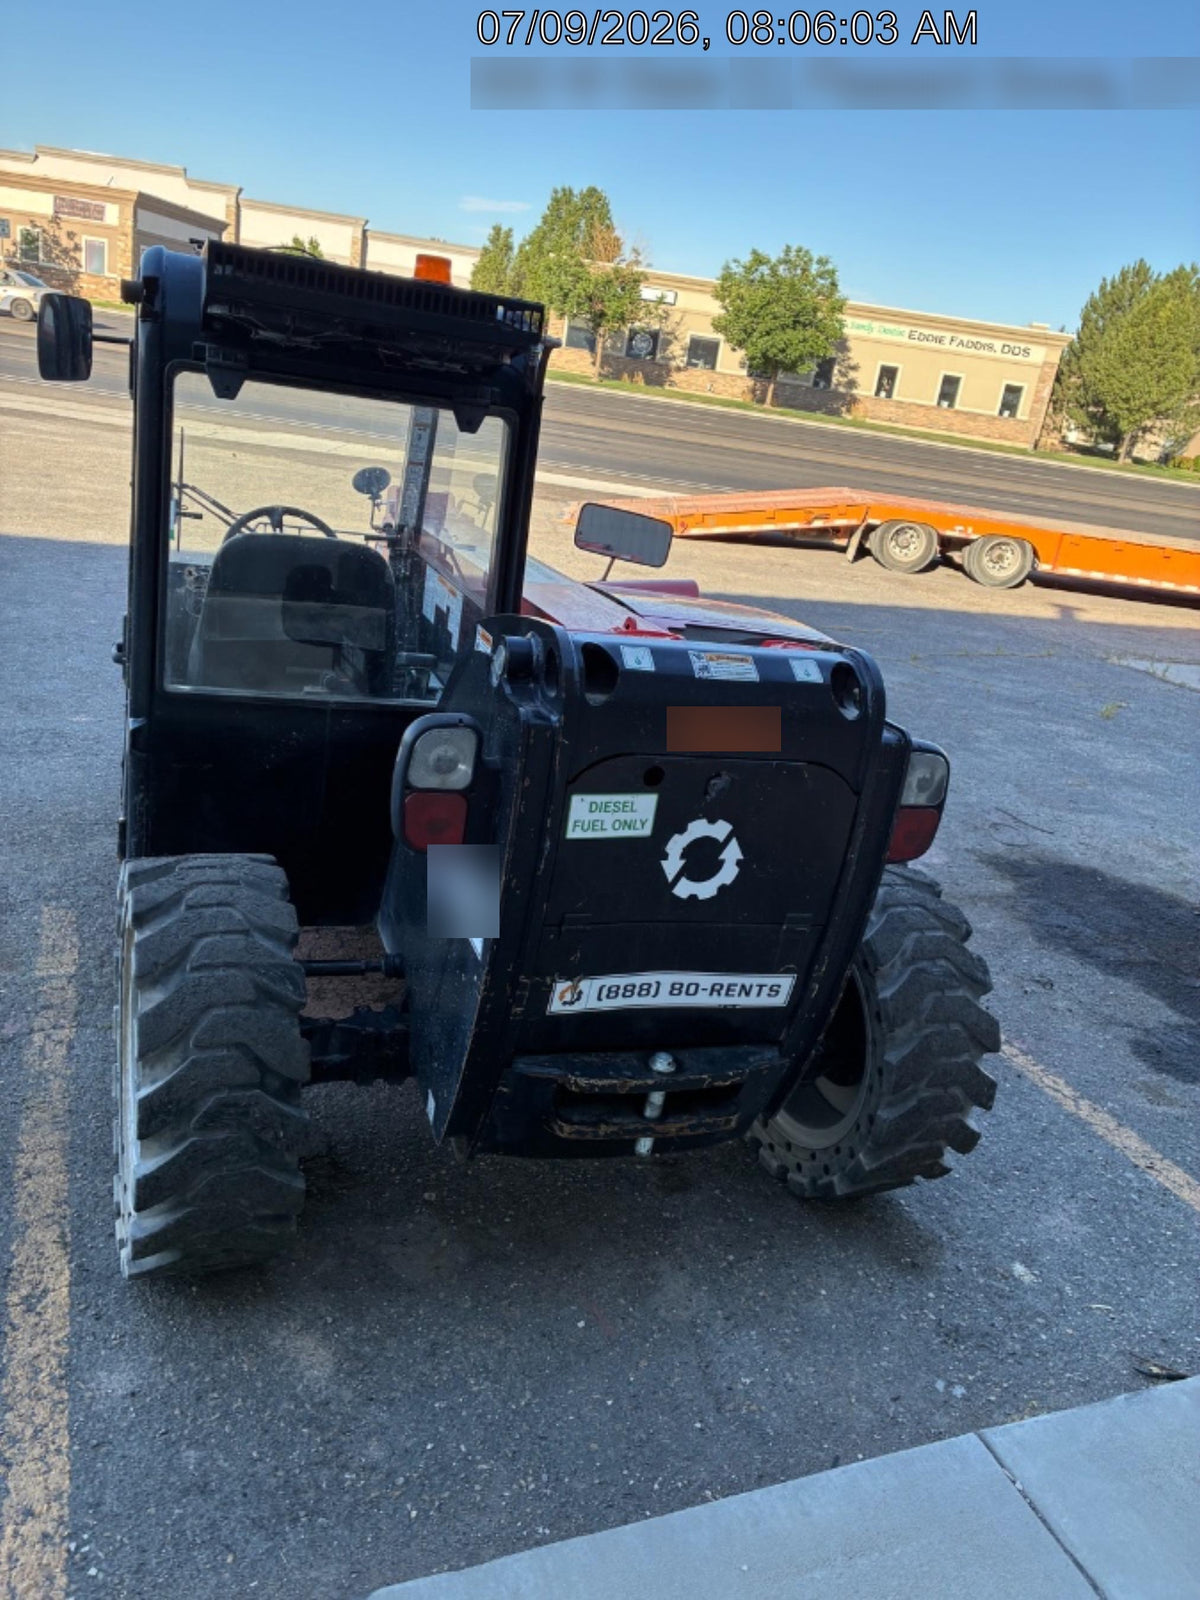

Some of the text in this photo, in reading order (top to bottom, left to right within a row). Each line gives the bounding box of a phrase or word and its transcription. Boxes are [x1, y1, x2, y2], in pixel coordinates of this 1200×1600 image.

[907, 329, 946, 345] EDDIE
[1001, 343, 1031, 358] DDS
[588, 801, 637, 813] DIESEL
[572, 818, 648, 832] FUEL ONLY
[597, 980, 782, 1001] (888) 80-RENTS
